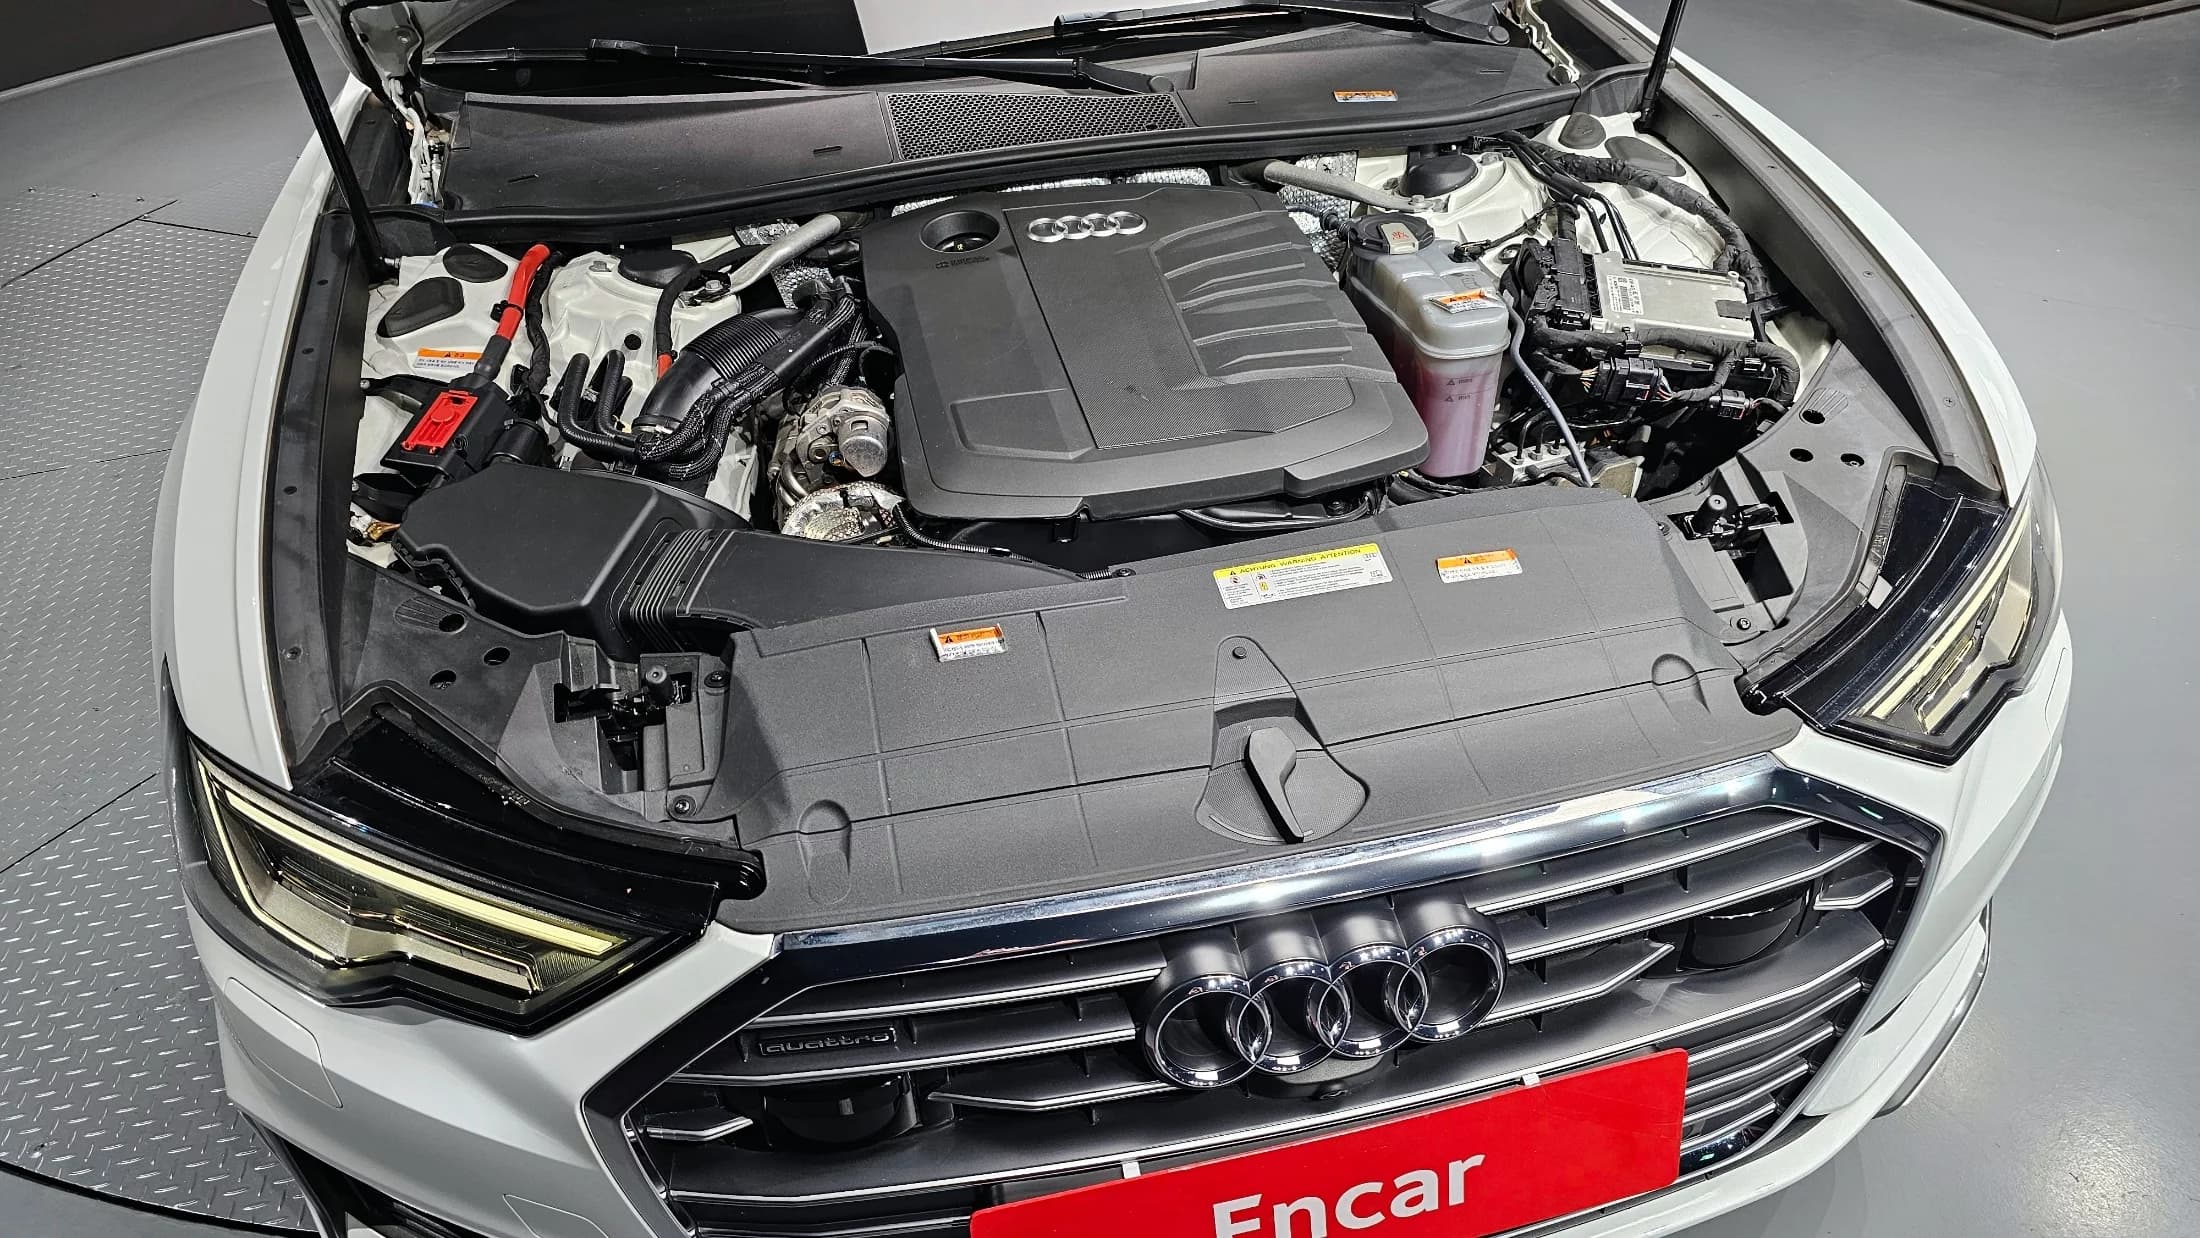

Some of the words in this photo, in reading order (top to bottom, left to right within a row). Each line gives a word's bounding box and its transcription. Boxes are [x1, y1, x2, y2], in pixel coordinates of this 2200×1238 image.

[1239, 563, 1276, 574] ACHTUNG
[1279, 556, 1317, 567] WARNING
[1320, 548, 1361, 560] ATTENTION
[766, 1032, 890, 1054] quattro
[1212, 1154, 1486, 1238] Encar
